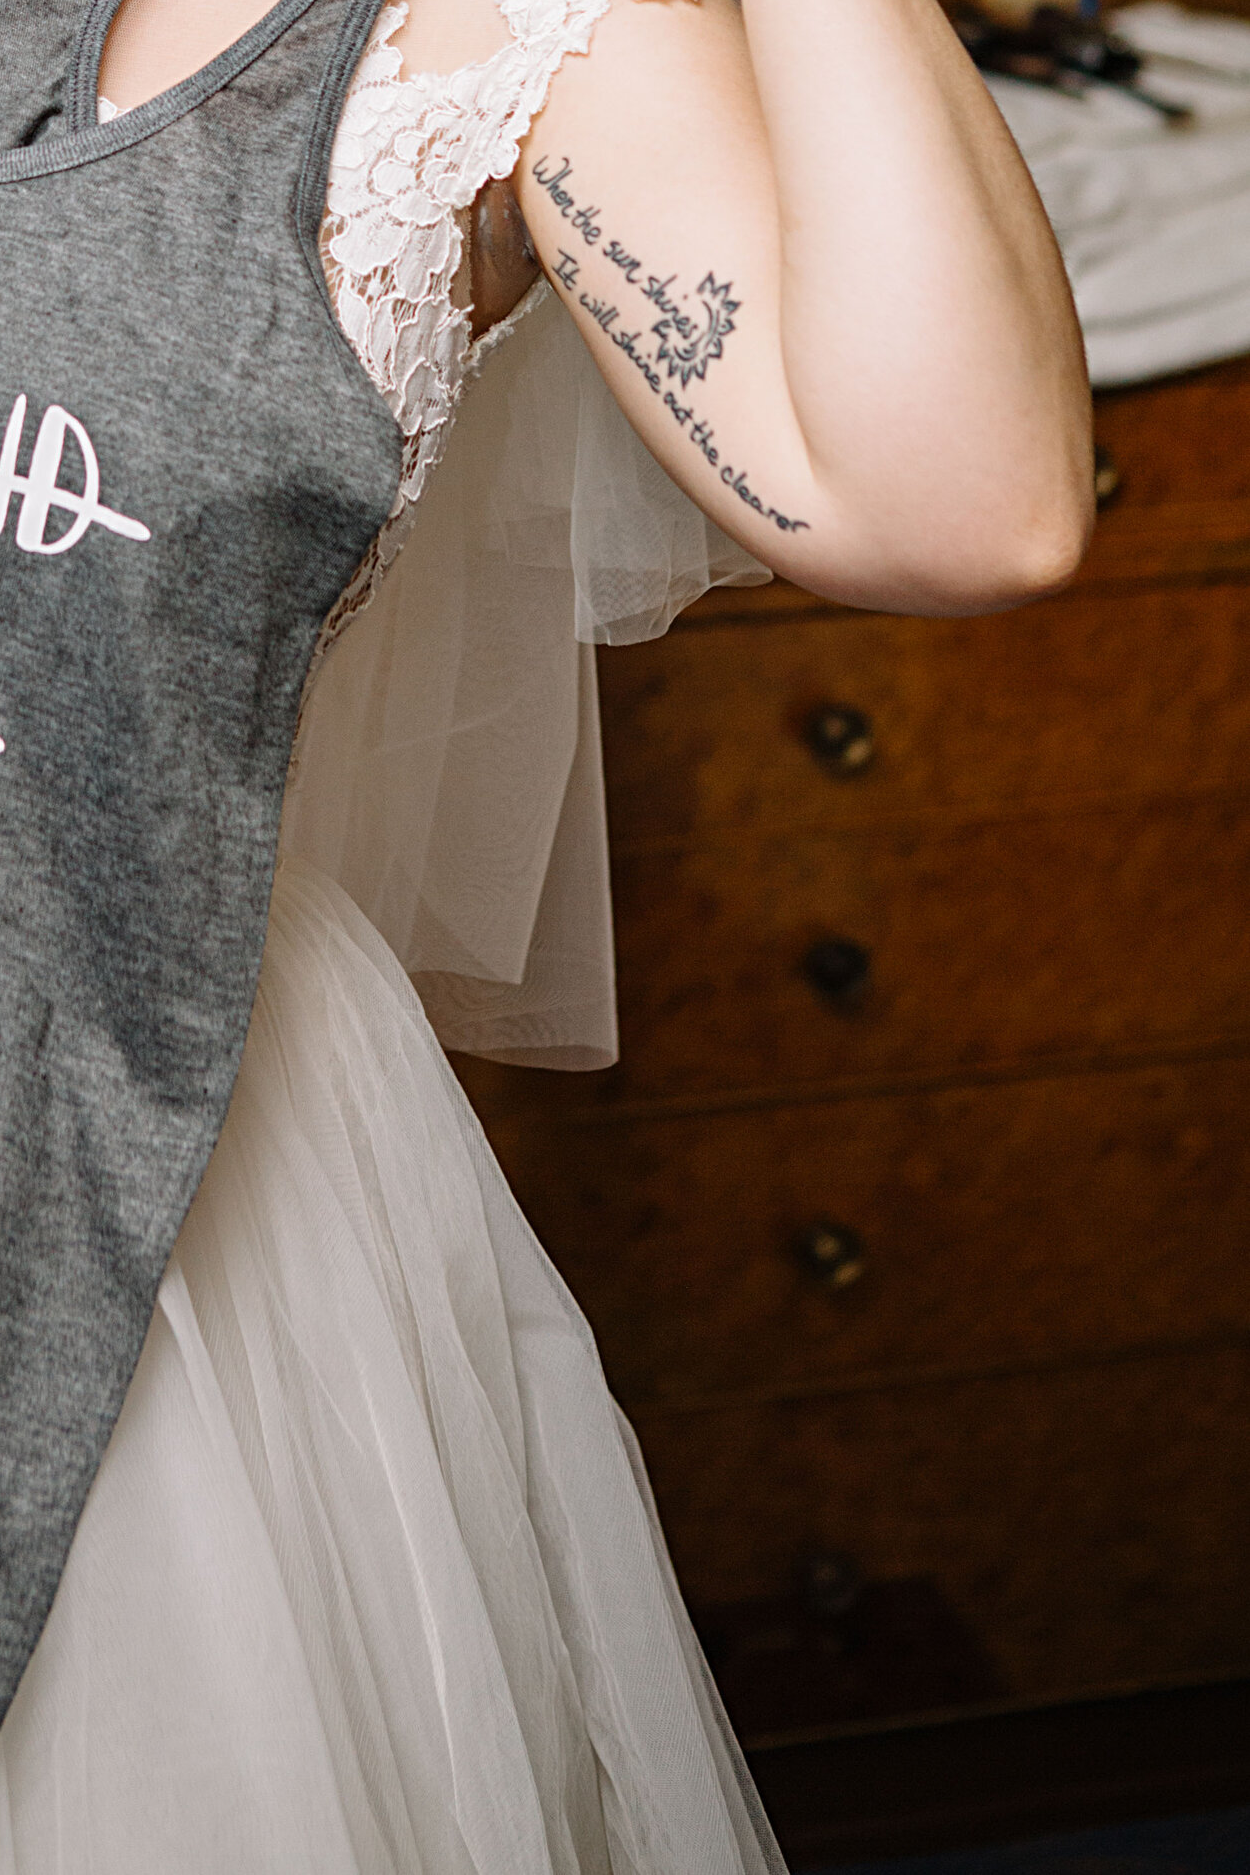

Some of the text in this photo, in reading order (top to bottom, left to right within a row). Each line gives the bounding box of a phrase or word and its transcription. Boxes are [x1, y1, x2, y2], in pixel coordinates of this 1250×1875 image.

[532, 154, 700, 340] When the sun shines
[551, 248, 811, 533] It will shine out the clearer
